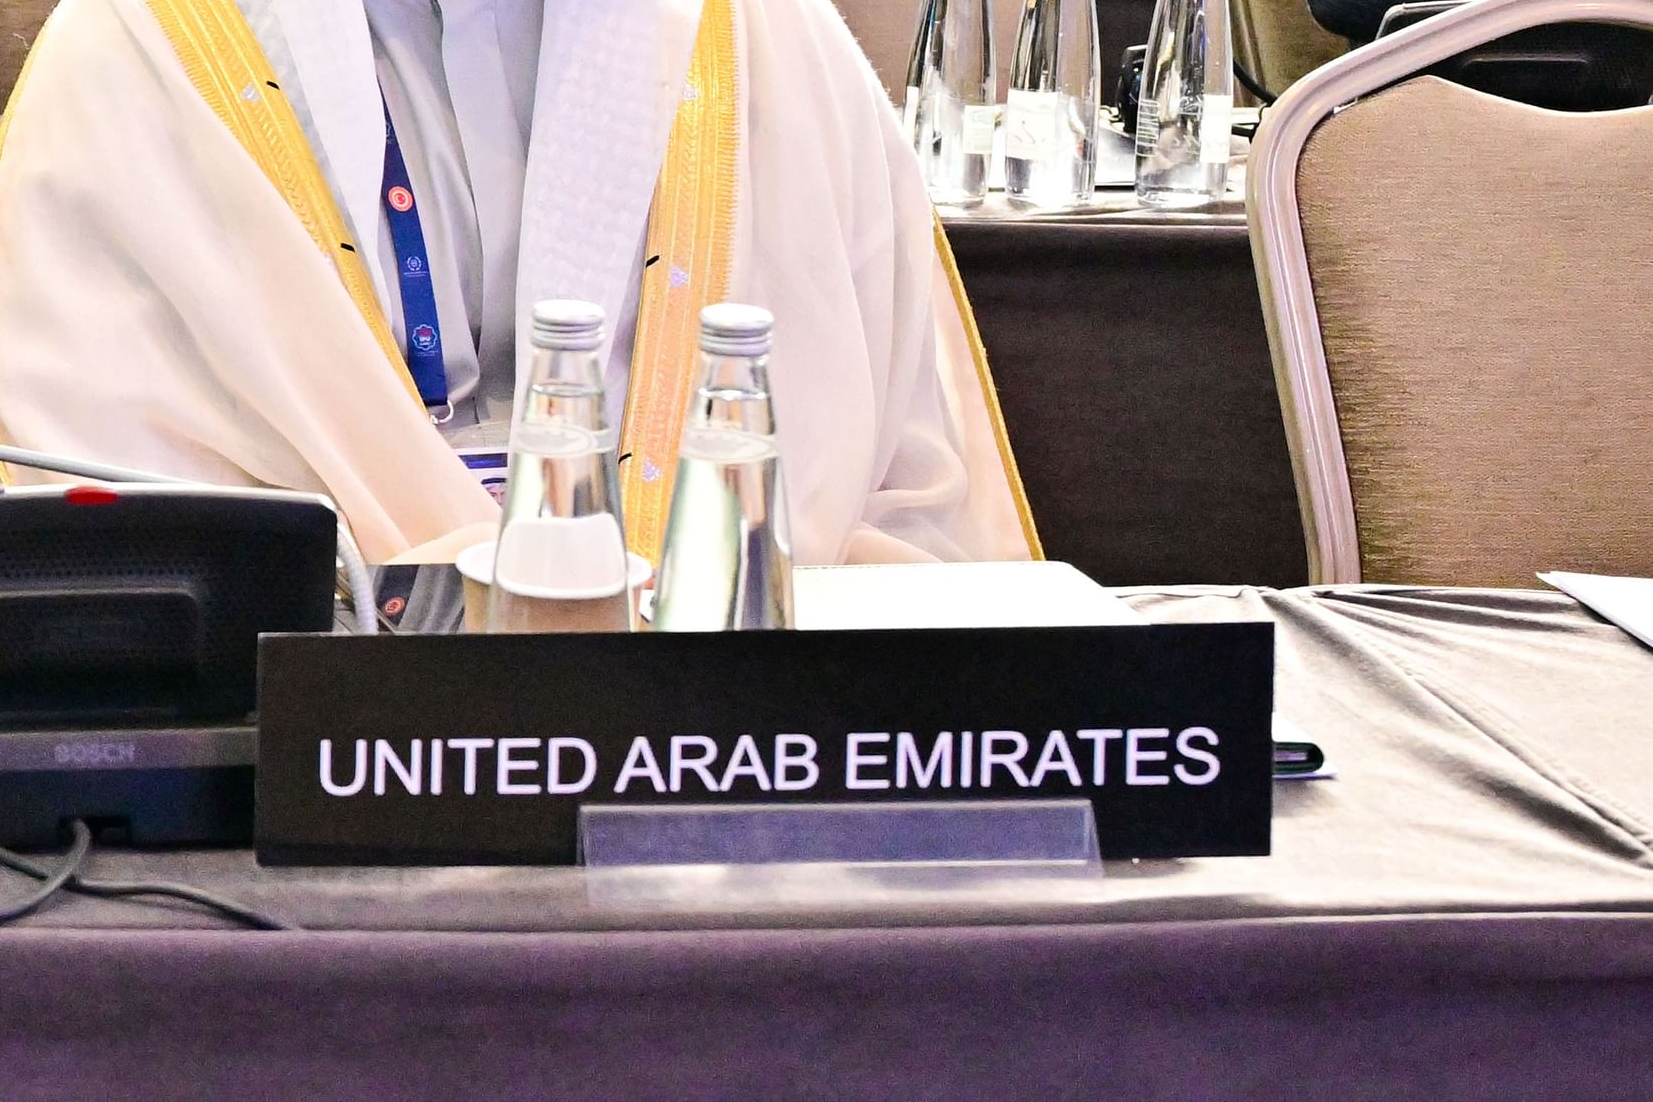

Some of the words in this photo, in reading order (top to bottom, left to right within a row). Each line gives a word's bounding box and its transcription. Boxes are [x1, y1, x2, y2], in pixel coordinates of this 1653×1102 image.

[319, 737, 598, 797] UNITED
[613, 733, 820, 793] ARAB
[845, 726, 1222, 790] EMIRATES
